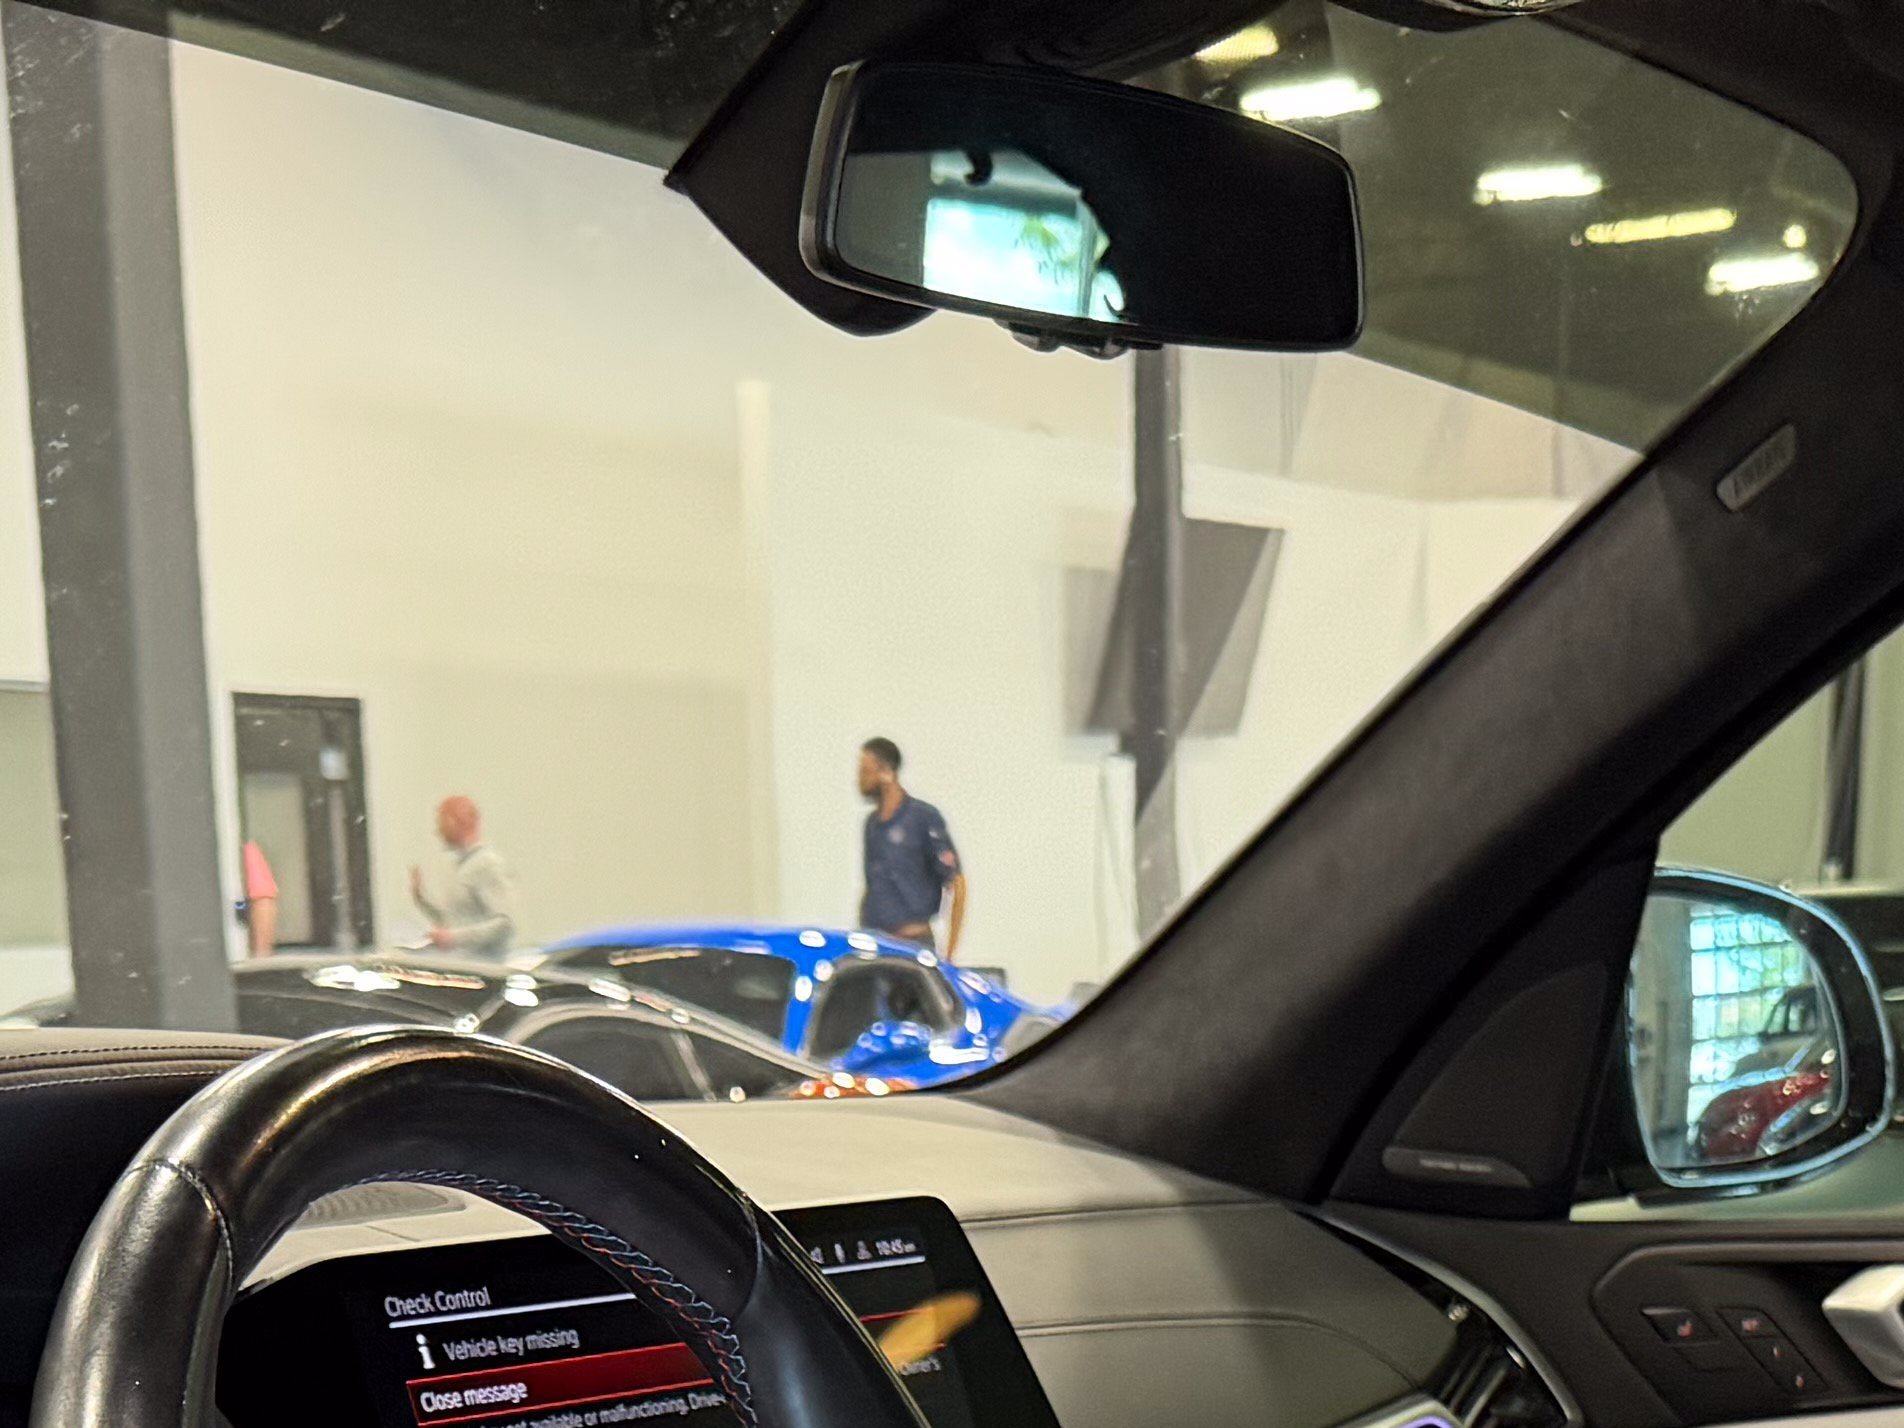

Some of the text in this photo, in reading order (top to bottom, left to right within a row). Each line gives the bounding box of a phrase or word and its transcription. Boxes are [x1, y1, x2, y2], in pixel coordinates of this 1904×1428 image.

[384, 1286, 491, 1318] Check Control
[443, 1327, 580, 1361] Vehicle key missing
[420, 1381, 528, 1414] Close message
[583, 1409, 598, 1426] or
